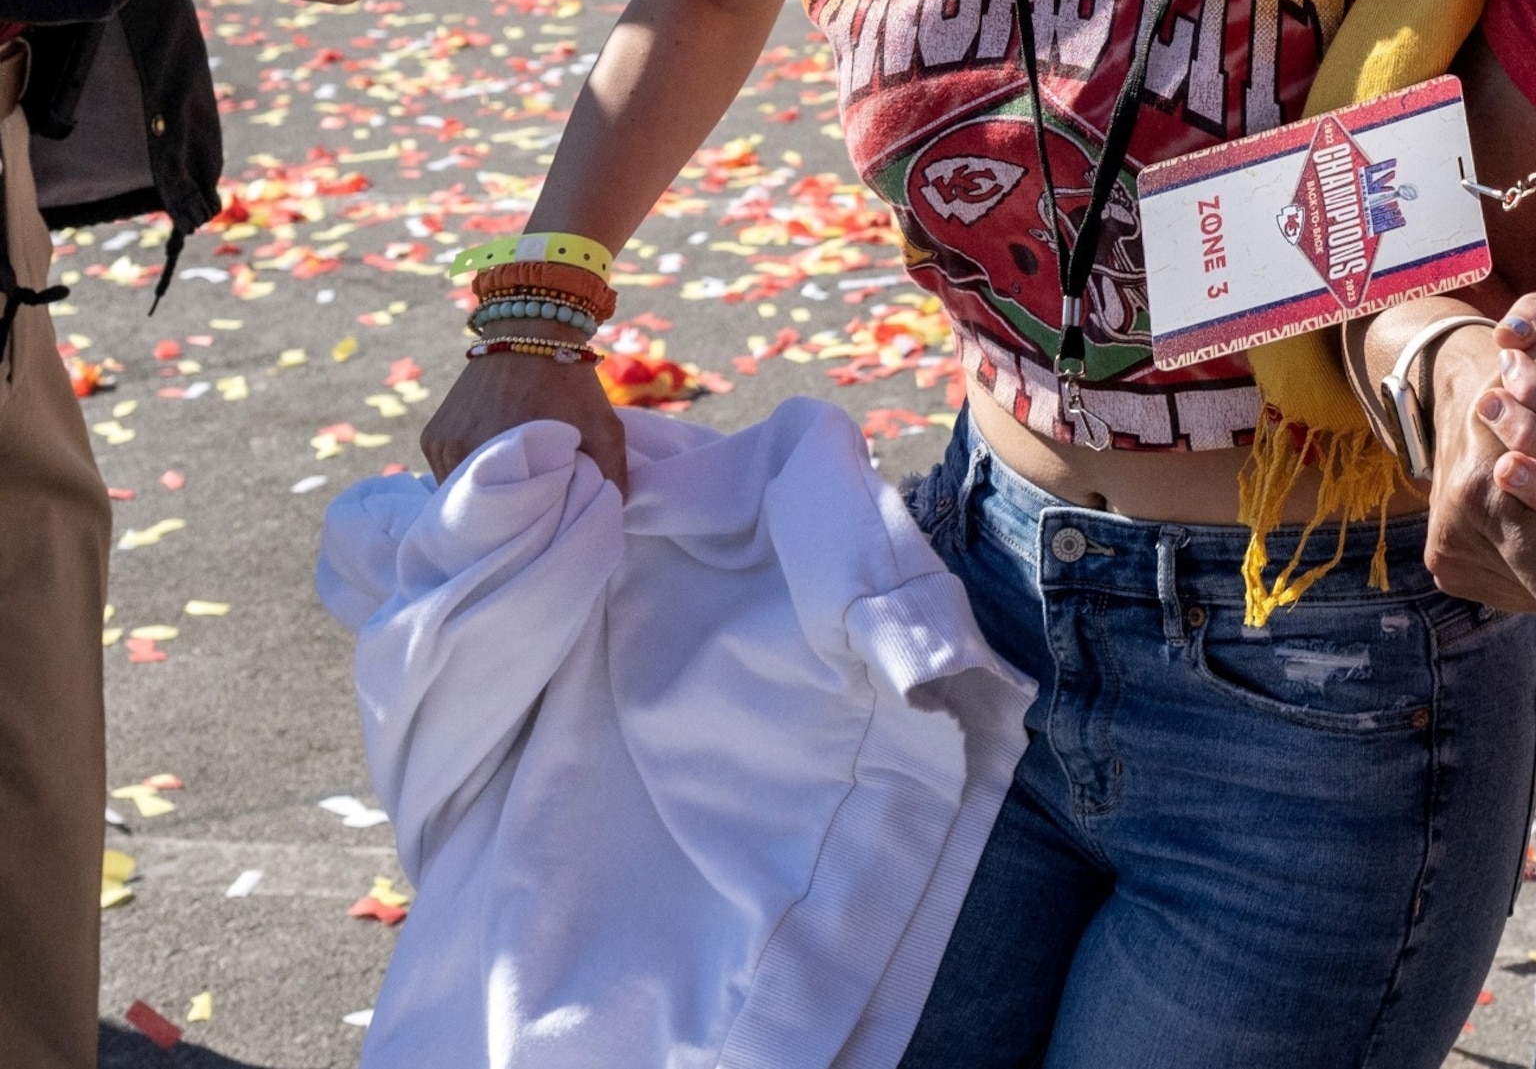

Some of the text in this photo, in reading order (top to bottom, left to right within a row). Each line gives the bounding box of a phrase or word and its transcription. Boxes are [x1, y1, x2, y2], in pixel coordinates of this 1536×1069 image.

[1324, 122, 1334, 144] 2022
[932, 164, 1004, 205] KC
[1313, 143, 1368, 280] CHAMPIONS
[1198, 195, 1229, 299] ZONE 3
